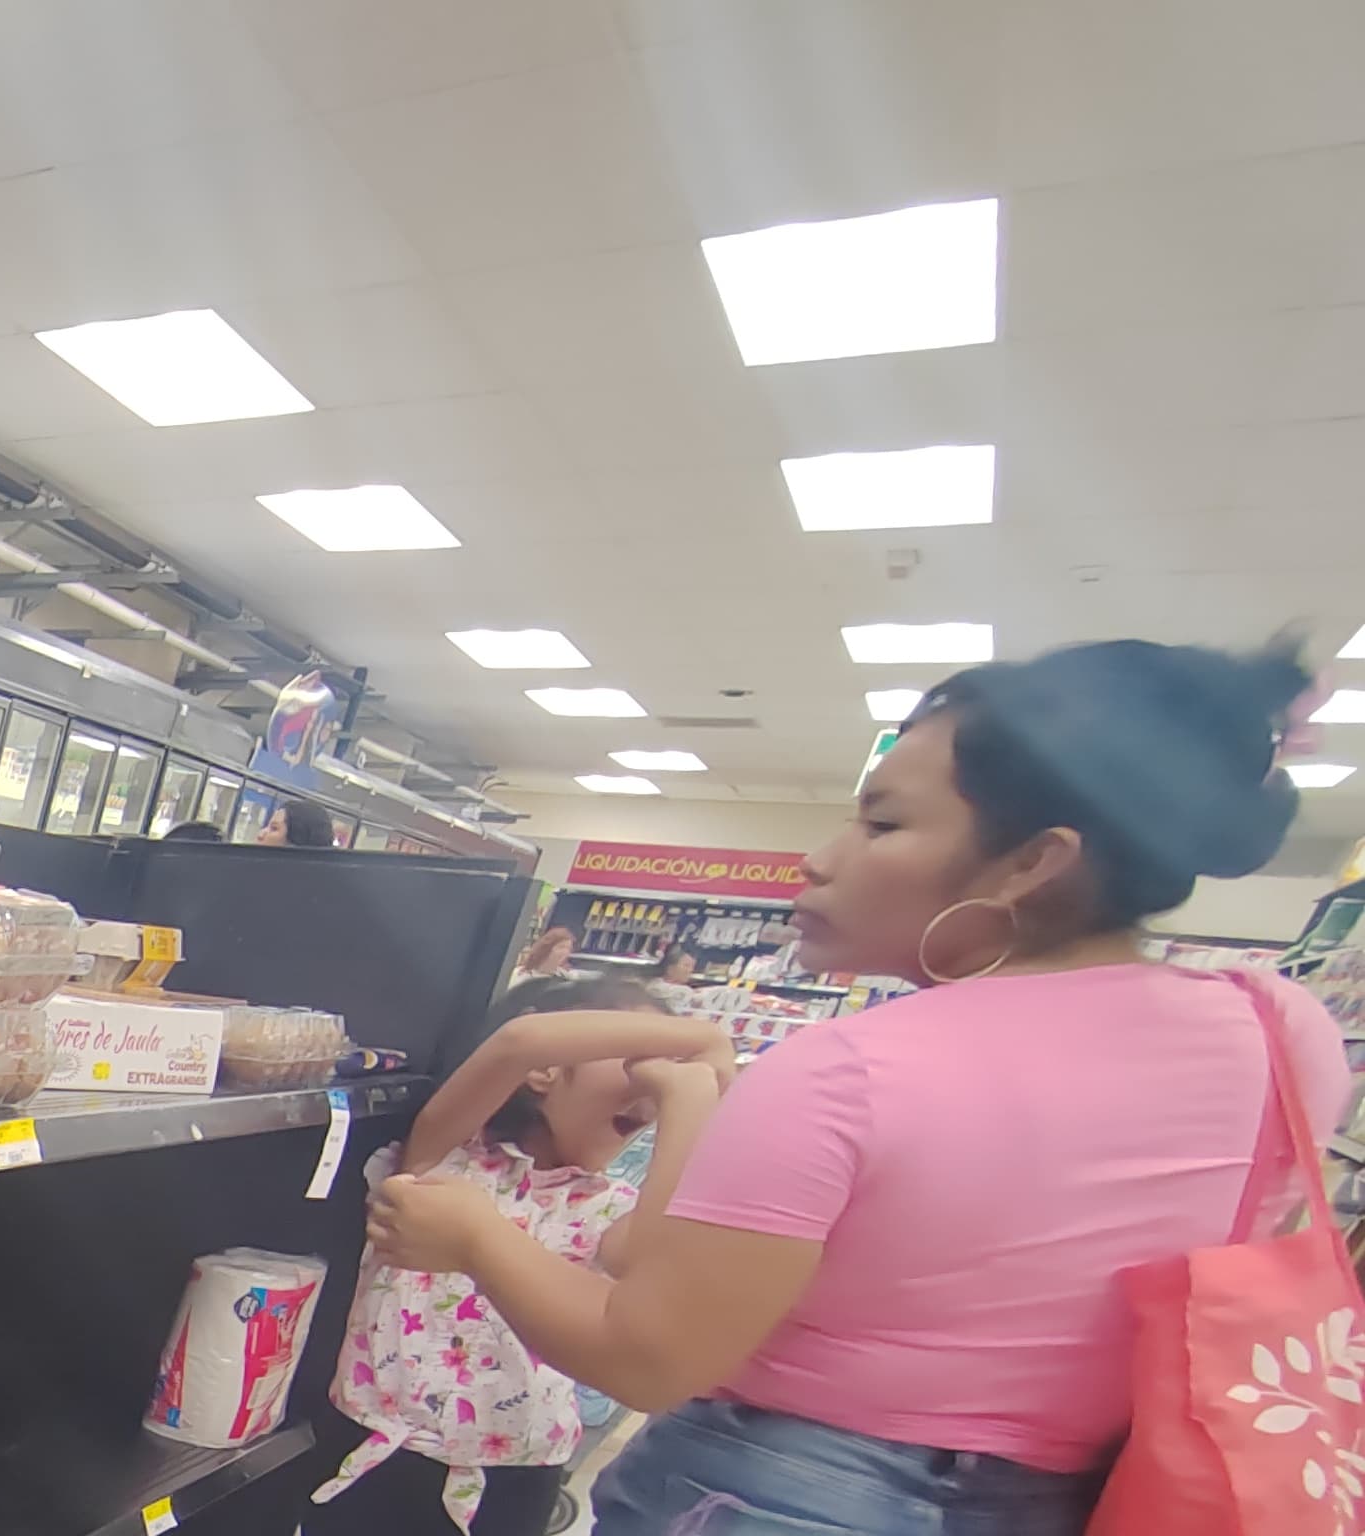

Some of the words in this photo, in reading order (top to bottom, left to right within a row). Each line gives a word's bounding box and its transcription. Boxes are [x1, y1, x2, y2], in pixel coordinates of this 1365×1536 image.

[574, 852, 704, 877] LIQUIDACIÓN
[729, 864, 807, 885] LIQUID
[93, 1019, 113, 1051] de
[113, 1023, 164, 1055] Jaula
[167, 1060, 208, 1074] Country
